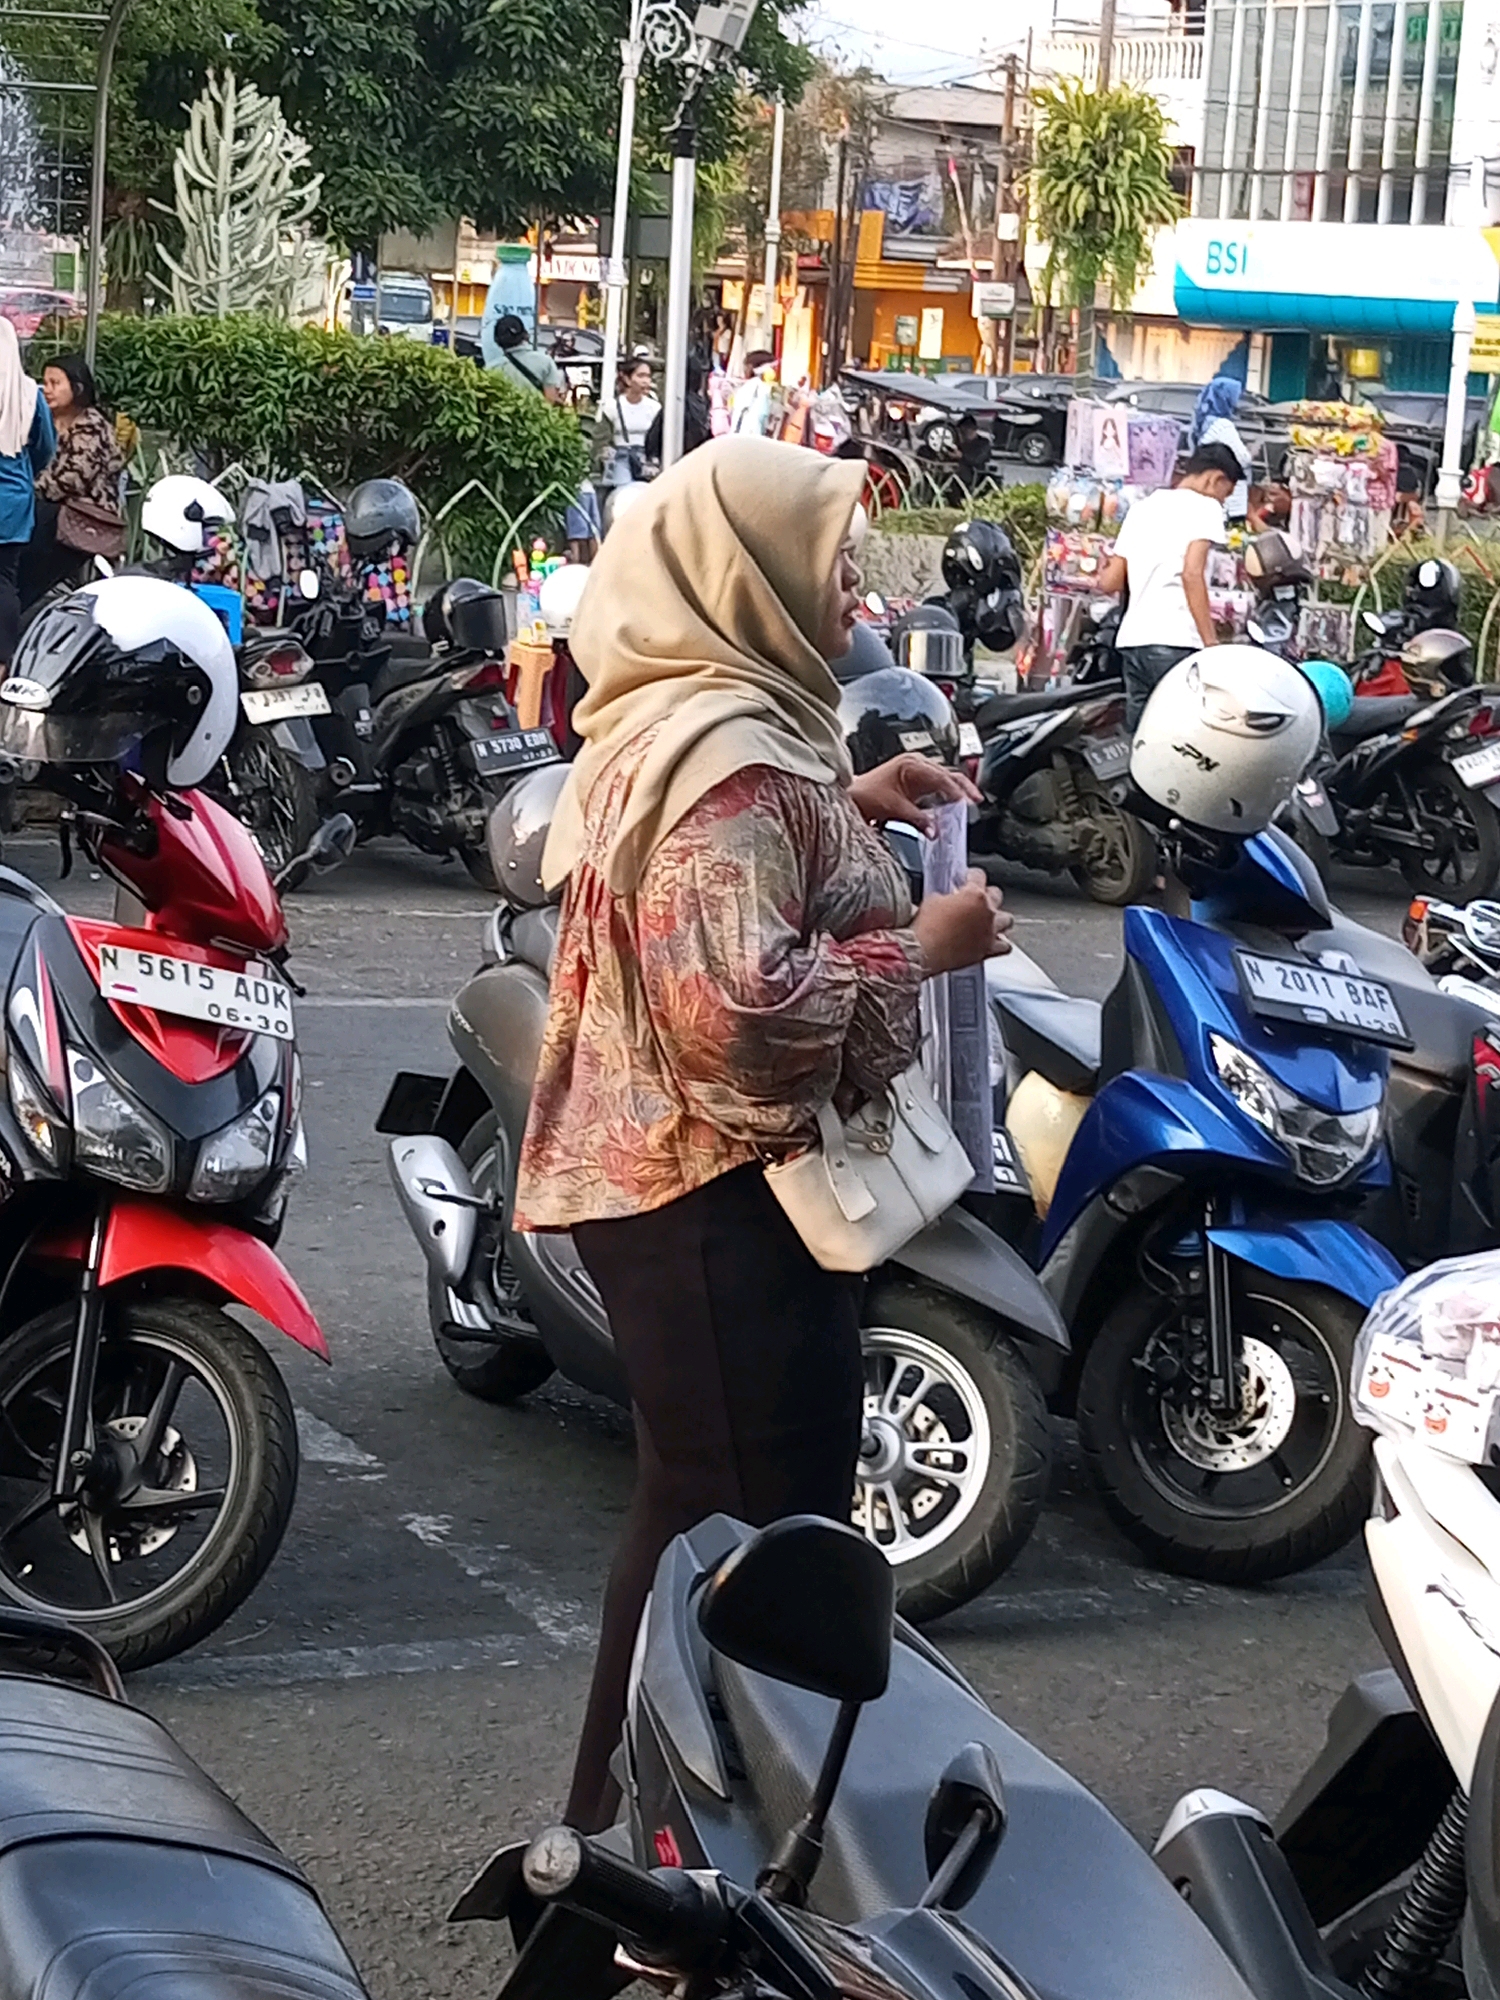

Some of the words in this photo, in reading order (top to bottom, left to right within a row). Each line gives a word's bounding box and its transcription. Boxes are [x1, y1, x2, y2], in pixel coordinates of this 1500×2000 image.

[1207, 241, 1246, 275] BSI
[101, 946, 119, 970] N
[138, 953, 214, 990] 5615
[234, 976, 288, 1011] ADK
[1245, 959, 1265, 985] N
[1275, 966, 1335, 999] 2011
[1345, 981, 1389, 1012] BAF
